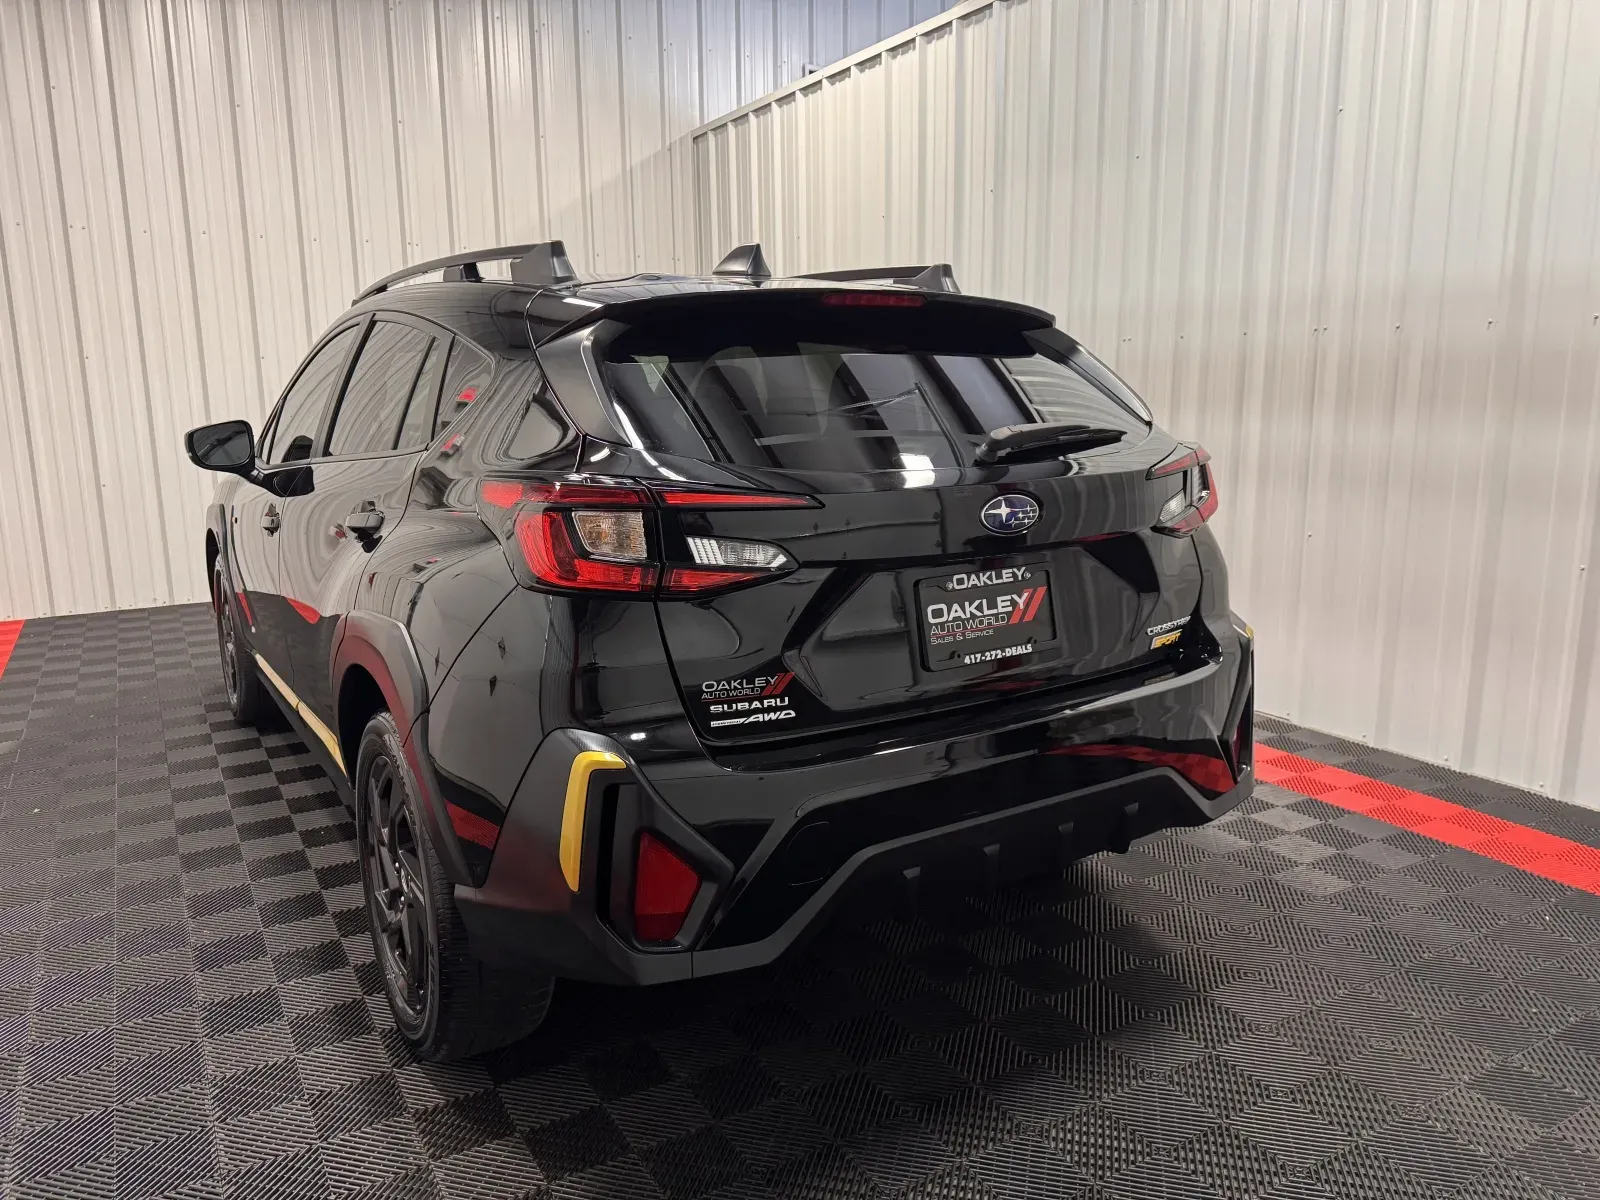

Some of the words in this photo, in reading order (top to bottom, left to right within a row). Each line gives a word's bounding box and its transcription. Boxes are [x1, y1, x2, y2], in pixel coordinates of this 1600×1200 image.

[952, 567, 1026, 589] OAKLEY
[927, 592, 1029, 623] OAKLEY
[930, 621, 963, 636] AUTO
[964, 613, 1008, 630] WORLD
[956, 633, 964, 641] &
[964, 644, 1033, 664] 417-272-DEALS
[702, 676, 778, 692] OAKLEY
[701, 691, 727, 699] AUTO
[729, 688, 760, 697] WORLD
[710, 697, 789, 713] SUBARU
[744, 710, 796, 724] AWD
